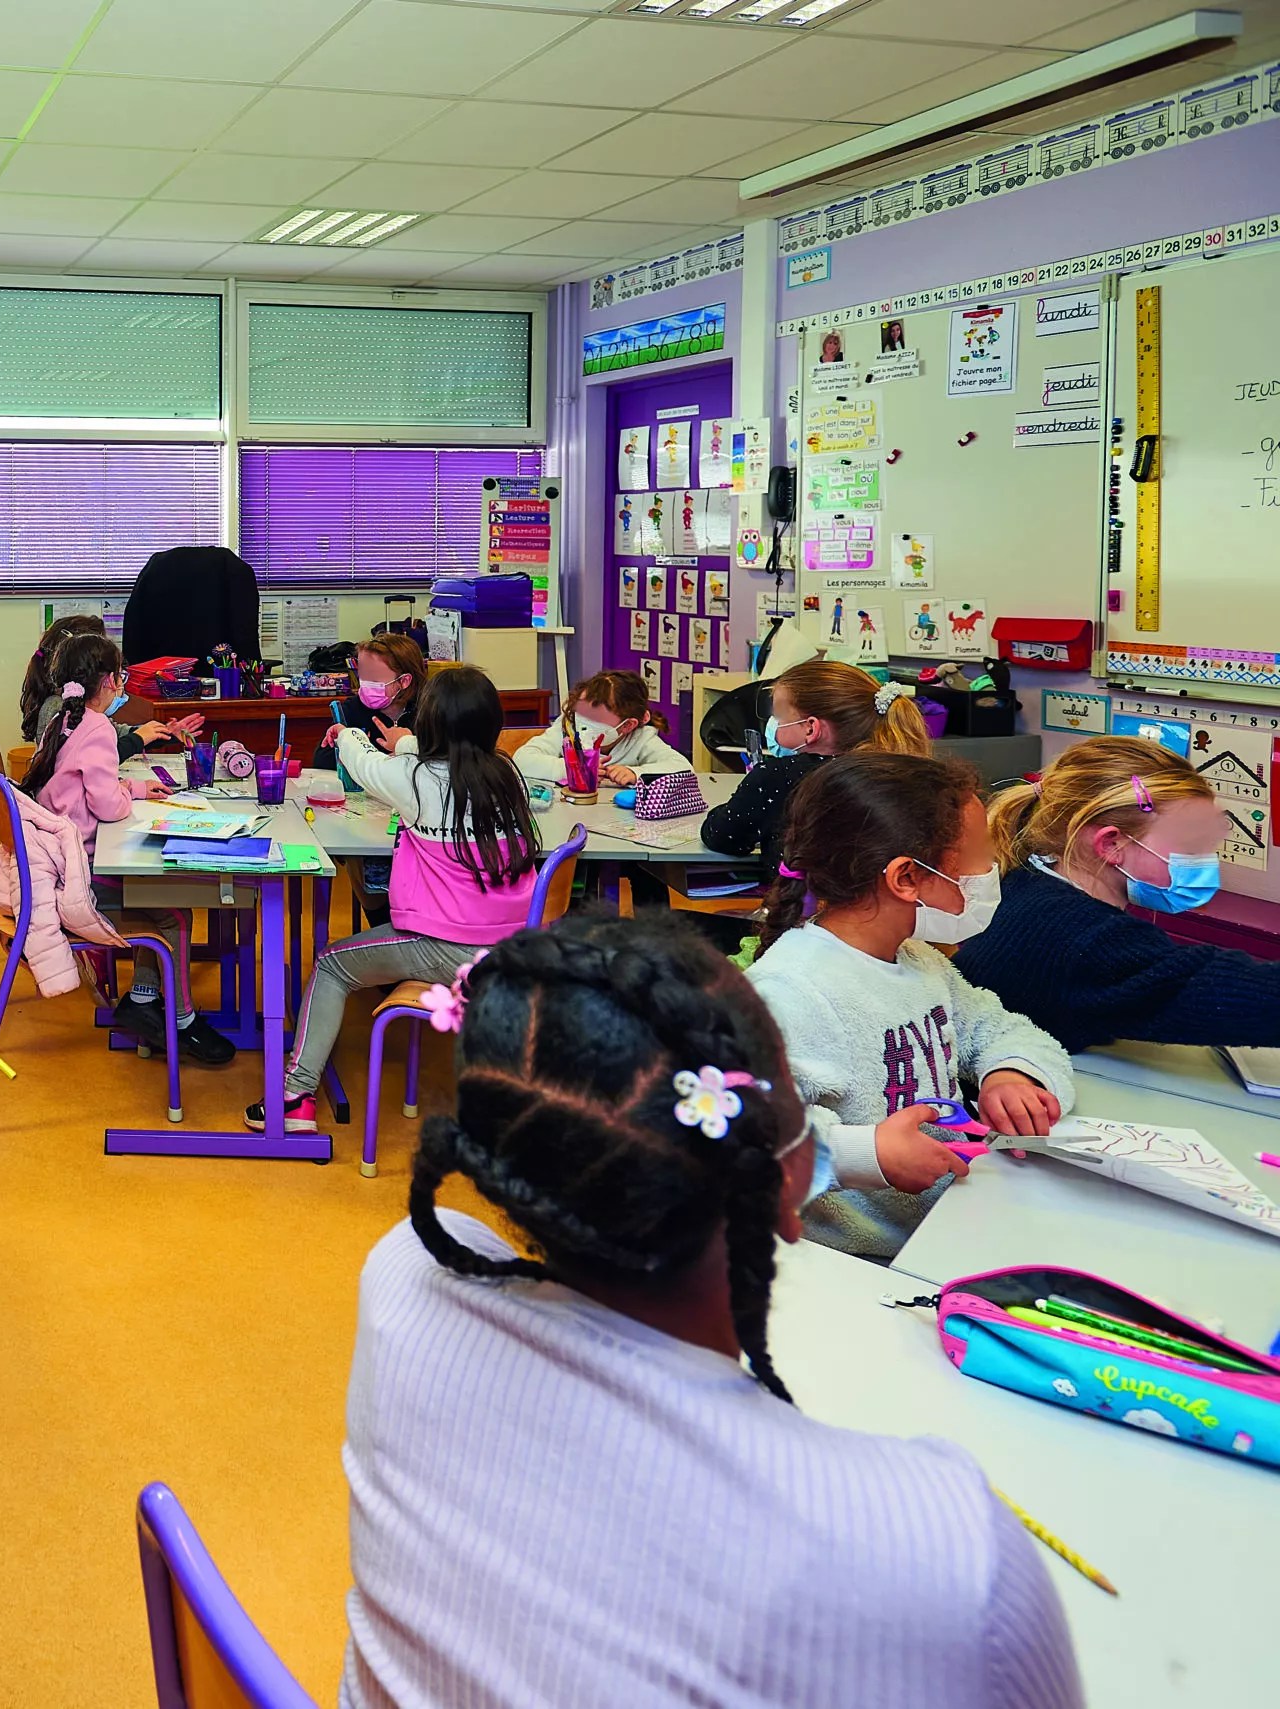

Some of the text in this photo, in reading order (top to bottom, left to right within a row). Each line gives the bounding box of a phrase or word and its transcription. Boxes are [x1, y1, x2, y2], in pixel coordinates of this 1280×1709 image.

[779, 326, 784, 334] 1
[789, 323, 795, 332] 2
[811, 318, 817, 327] 4
[822, 316, 828, 325] 5
[833, 313, 839, 322] 6
[846, 311, 851, 320] 7
[857, 309, 863, 318] 8
[870, 306, 876, 315] 9
[881, 303, 890, 313] 10
[894, 300, 903, 310] 11
[907, 297, 917, 307] 12
[920, 294, 930, 304] 13
[934, 291, 944, 301] 14
[948, 288, 958, 298] 15
[963, 286, 973, 296] 16
[977, 282, 988, 293] 17
[992, 279, 1003, 289] 18
[1007, 275, 1019, 286] 19
[1021, 272, 1034, 283] 20
[1038, 269, 1051, 280] 21
[1055, 265, 1069, 276] 22
[1072, 261, 1086, 273] 23
[1090, 257, 1103, 270] 24
[1108, 254, 1122, 266] 25
[1126, 250, 1141, 262] 26
[1145, 246, 1160, 258] 27
[1165, 241, 1180, 253] 28
[1185, 237, 1202, 250] 29
[1205, 233, 1221, 246] 30
[1226, 229, 1242, 242] 31
[1248, 224, 1266, 237] 32
[1037, 298, 1092, 323] lundi
[951, 378, 997, 387] fichier page
[1042, 372, 1097, 406] jeudi
[1016, 415, 1099, 435] vendredi
[827, 579, 886, 588] Les personnages
[1062, 704, 1089, 718] calcul
[1119, 701, 1278, 729] 1 2 3 4 5 6 7 8 9
[1094, 1365, 1219, 1430] Cupcake
